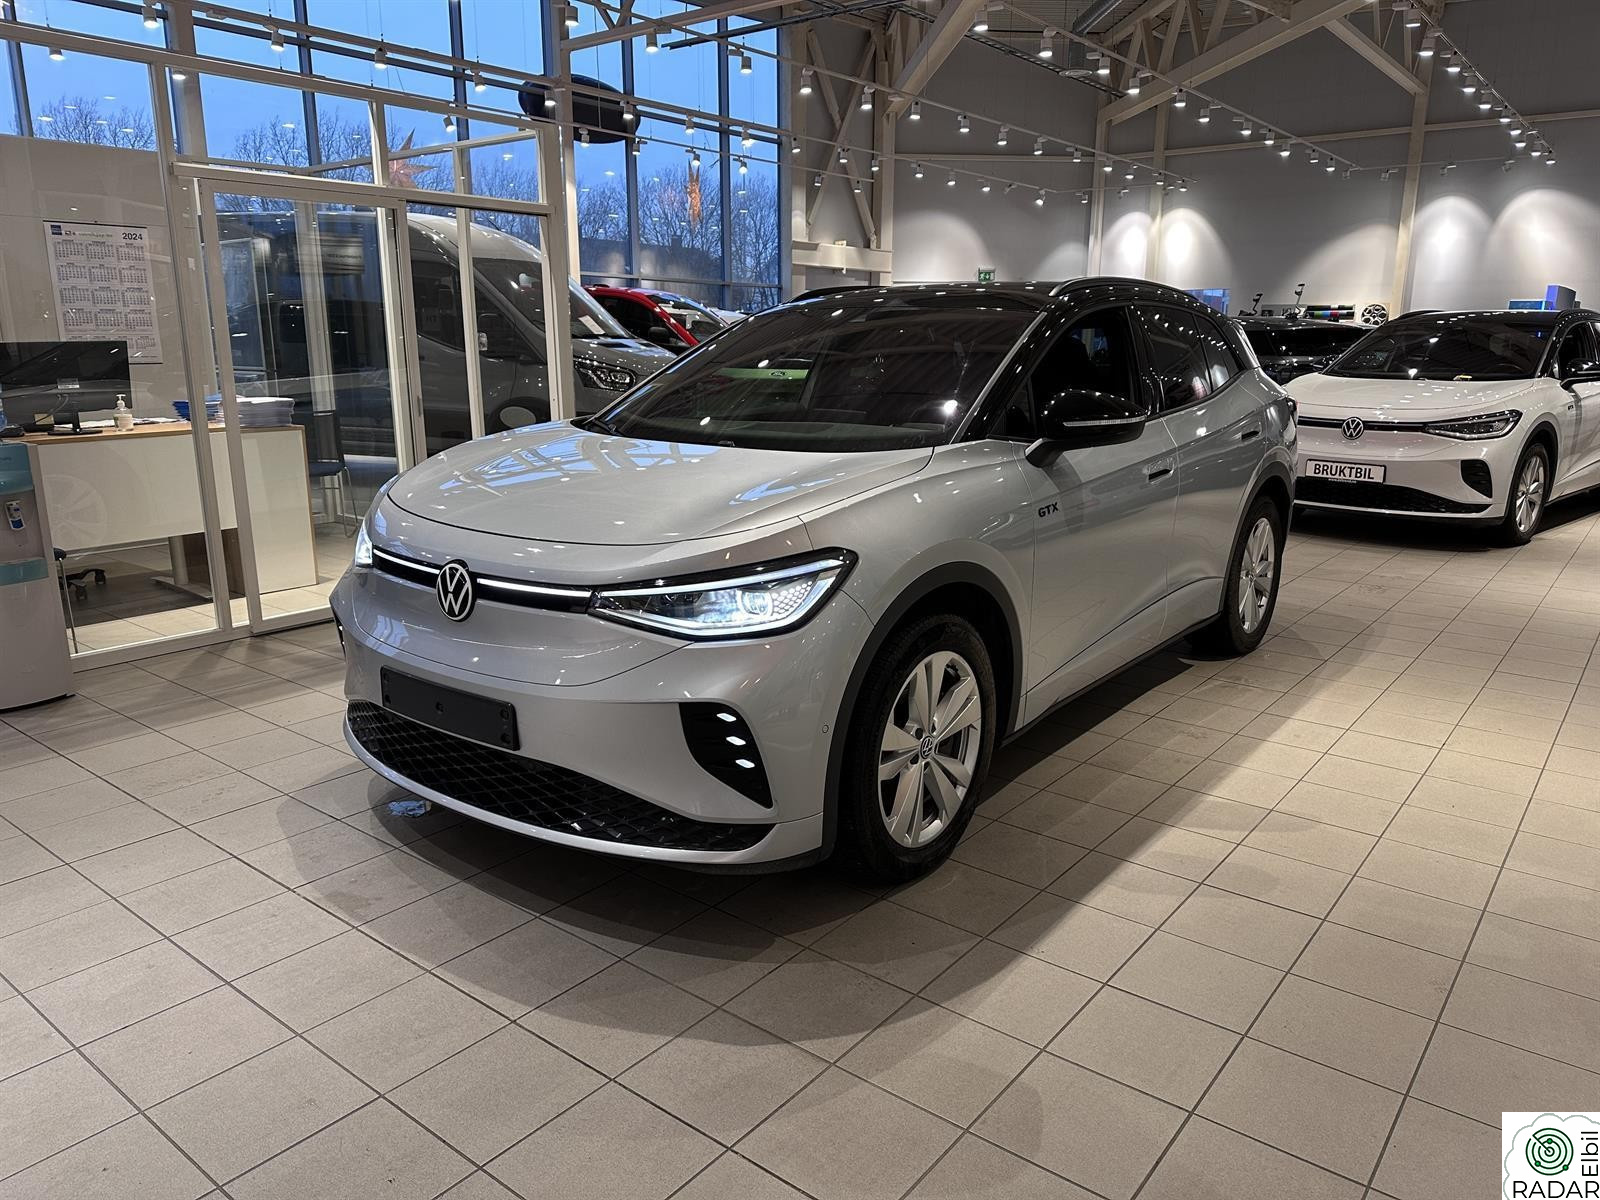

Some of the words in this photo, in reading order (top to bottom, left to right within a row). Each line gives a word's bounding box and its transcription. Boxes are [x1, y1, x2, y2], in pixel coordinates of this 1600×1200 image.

[122, 232, 143, 240] 2024
[1343, 418, 1363, 437] VW
[1313, 463, 1375, 480] BRUKTBIL
[1038, 501, 1059, 518] GTX
[437, 564, 470, 617] VW
